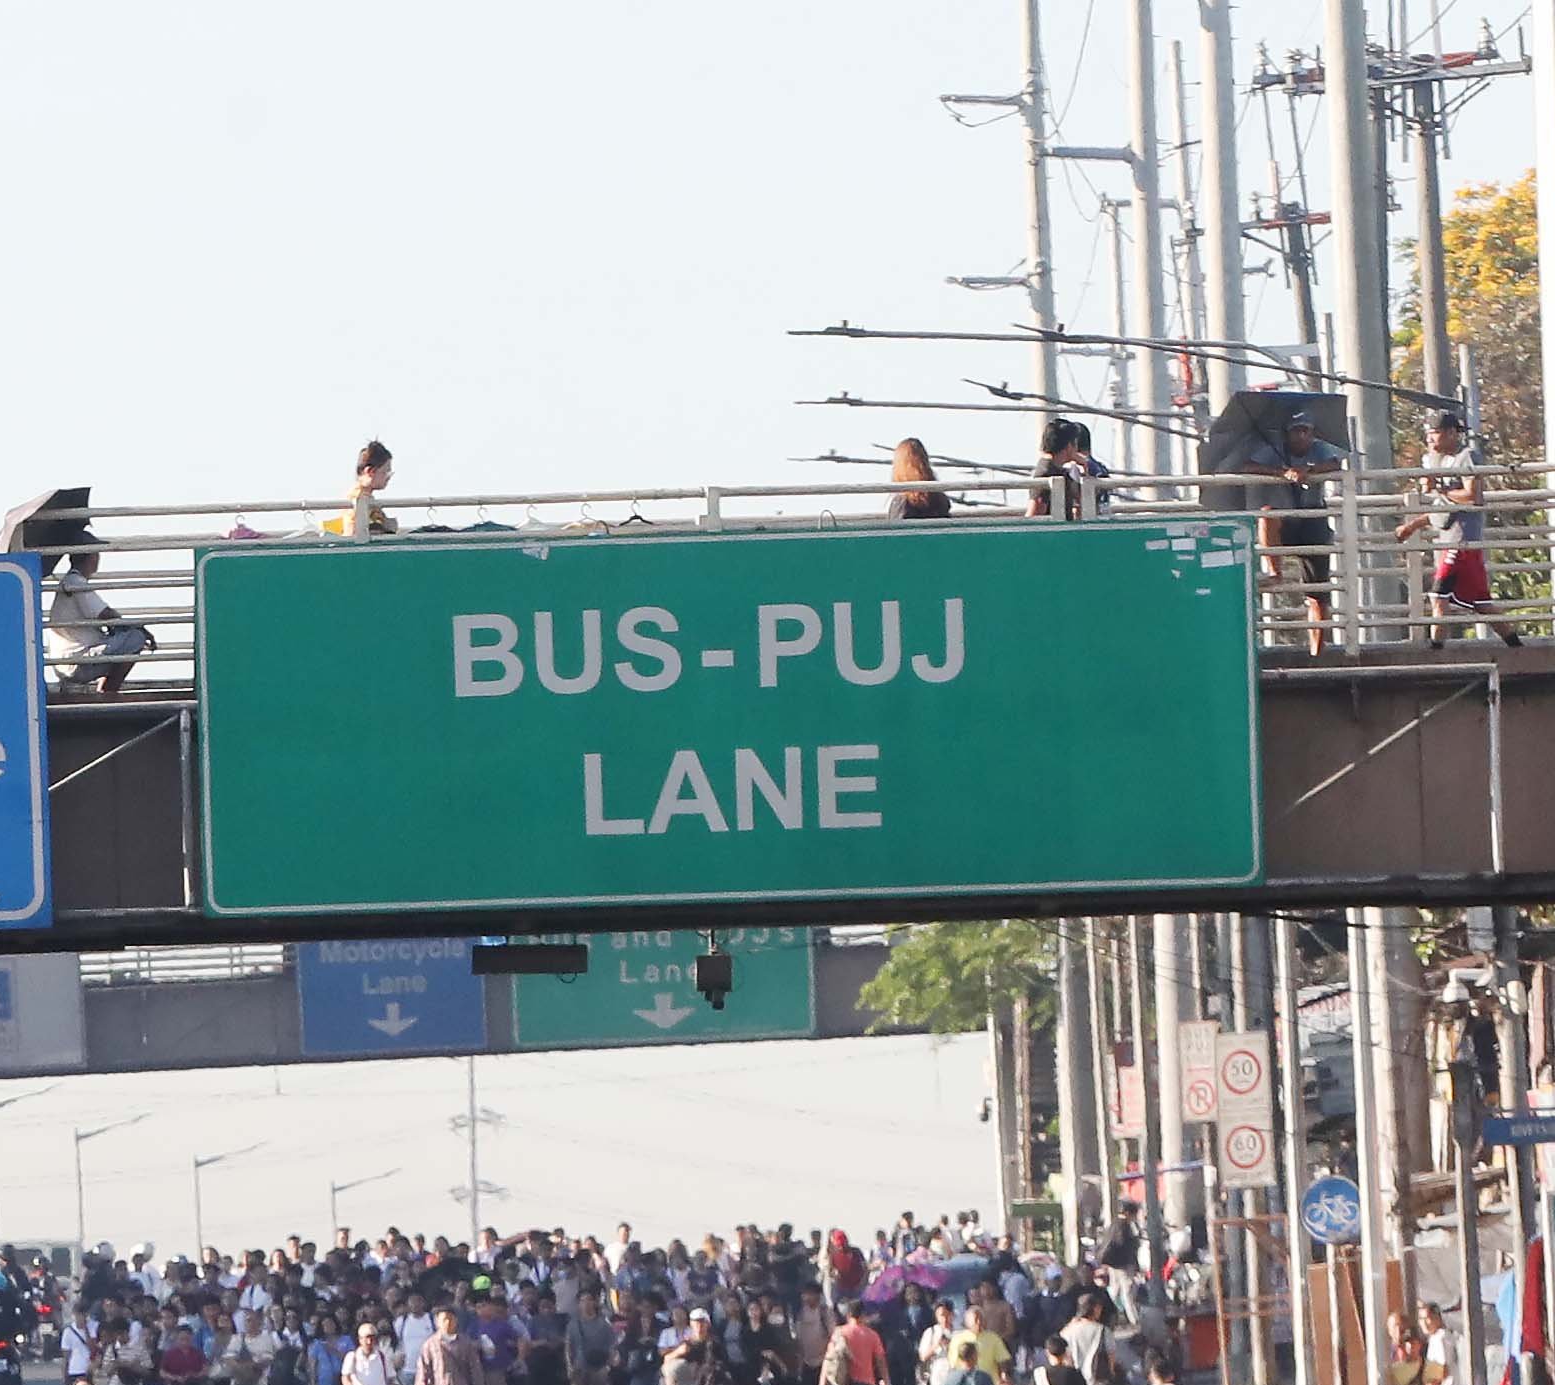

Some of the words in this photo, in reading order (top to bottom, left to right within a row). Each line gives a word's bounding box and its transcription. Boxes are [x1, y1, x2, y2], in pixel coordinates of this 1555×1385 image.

[452, 597, 965, 697] BUS-PUJ
[583, 744, 884, 836] LANE
[318, 938, 465, 967] Motorcycle
[362, 973, 427, 996] Lane
[620, 961, 697, 984] Lane
[1232, 1059, 1253, 1076] 50
